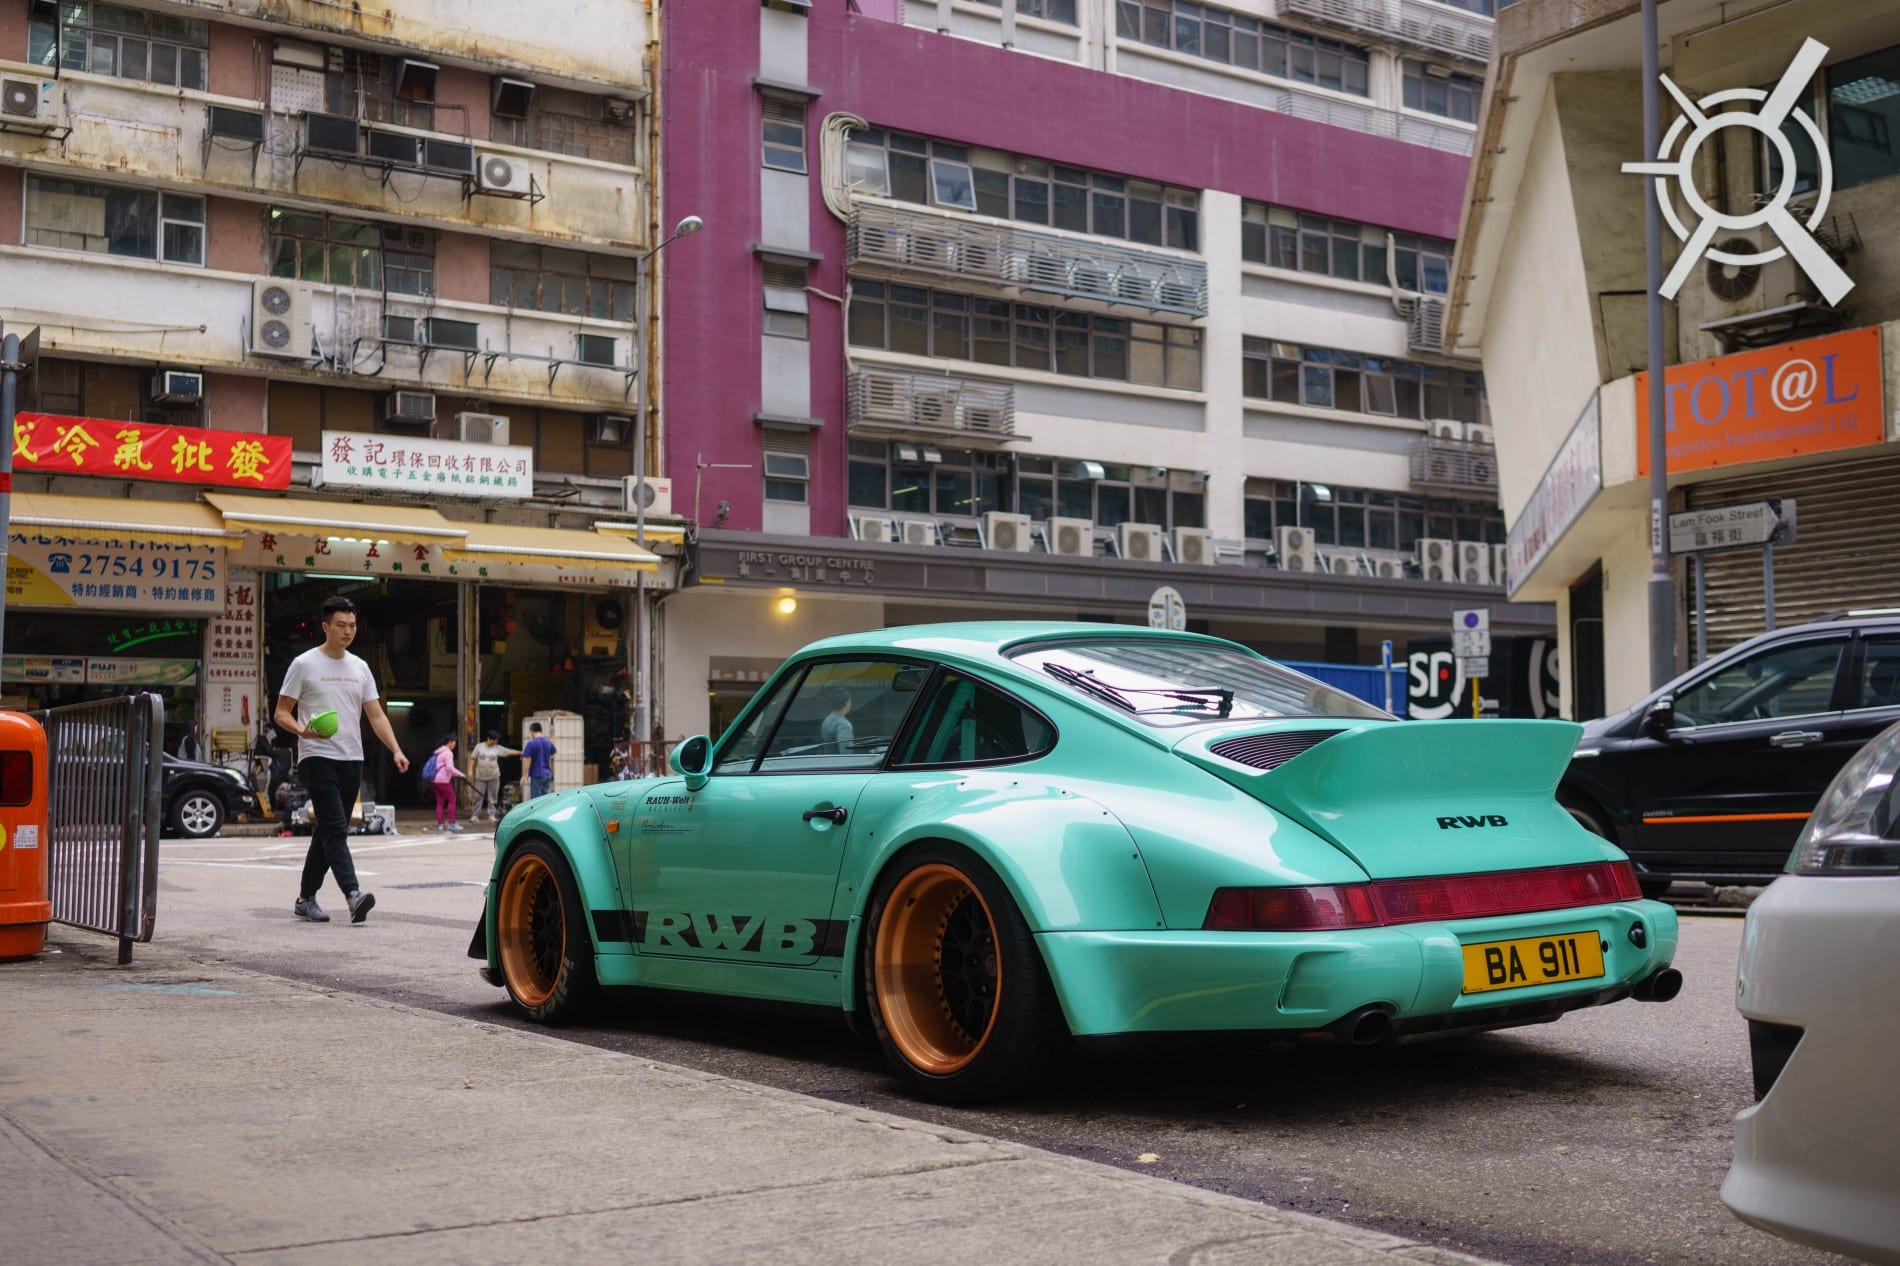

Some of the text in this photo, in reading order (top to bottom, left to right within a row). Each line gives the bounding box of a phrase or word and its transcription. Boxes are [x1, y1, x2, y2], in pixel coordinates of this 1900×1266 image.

[1666, 411, 1857, 459] gistics International Ltd
[1672, 508, 1764, 528] Lam Fook Street
[79, 554, 216, 580] 2754 9175
[739, 552, 875, 571] FIRST GROUP CENTRE
[646, 796, 690, 805] RAUH-Welt
[1436, 815, 1509, 830] RWB
[645, 910, 818, 956] RWB
[1484, 938, 1581, 986] BA 911
